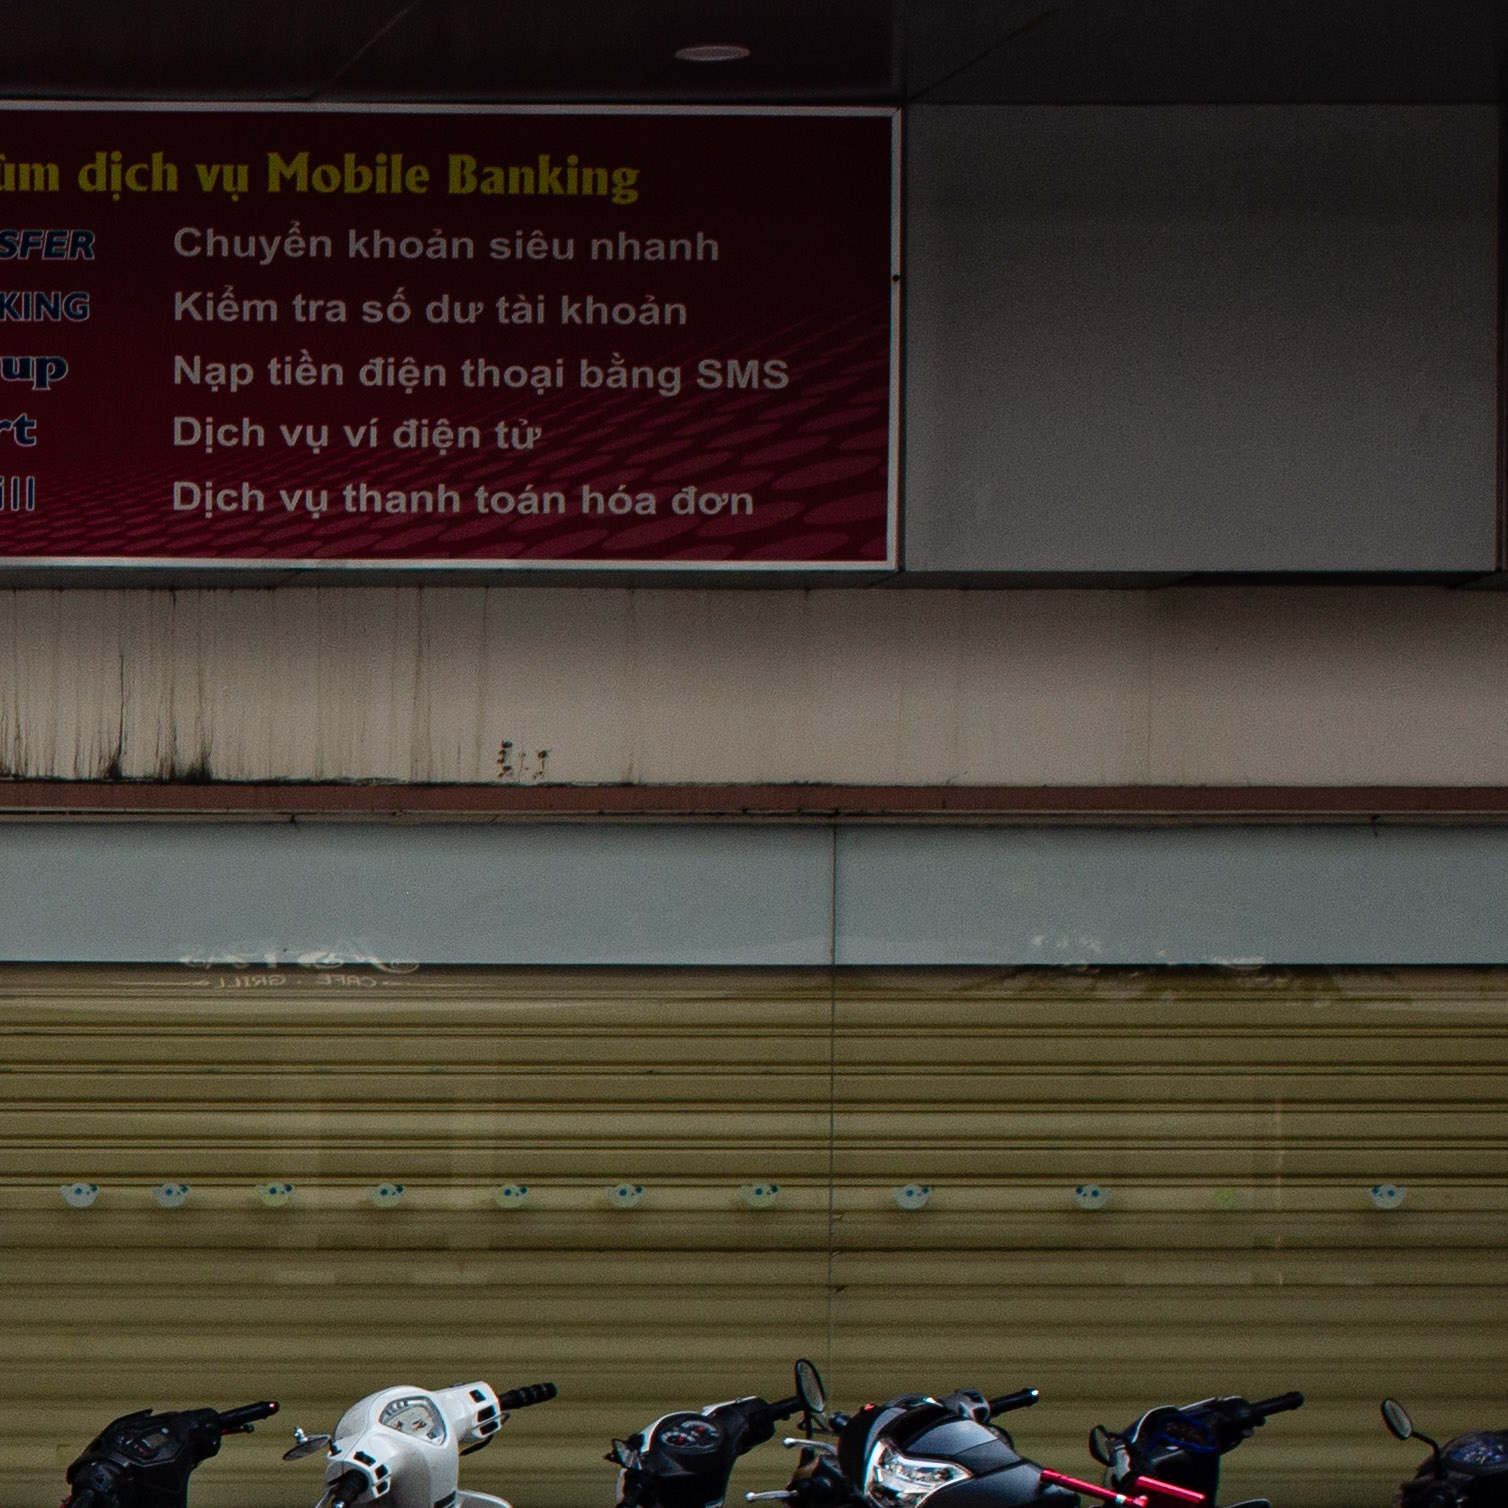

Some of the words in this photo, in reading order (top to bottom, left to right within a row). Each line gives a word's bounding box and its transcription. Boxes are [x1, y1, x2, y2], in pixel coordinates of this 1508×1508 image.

[76, 150, 179, 202] dịch
[194, 161, 250, 202] vụ
[266, 152, 431, 196] Mobile
[446, 152, 641, 206] Banking
[172, 220, 333, 266] Chuyển
[347, 226, 475, 261] khoản
[488, 227, 576, 261] siêu
[589, 231, 721, 262] nhanh
[173, 285, 278, 324] Kiểm
[291, 293, 348, 323] tra
[360, 286, 412, 324] số
[425, 293, 485, 324] dư
[495, 293, 546, 325] tài
[560, 294, 689, 326] khoản
[173, 354, 255, 394] Nạp
[267, 348, 345, 388] tiền
[358, 355, 448, 394] điện
[460, 356, 565, 395] thoại
[579, 350, 683, 399] bằng
[695, 358, 790, 391] SMS
[172, 415, 266, 454] Dịch
[279, 424, 330, 454] vụ
[343, 416, 379, 449] ví
[391, 417, 482, 456] điện
[494, 419, 544, 451] tử
[172, 480, 266, 519] Dịch
[279, 489, 330, 519] vụ
[343, 482, 461, 515] thanh
[474, 482, 567, 516] toán
[580, 483, 658, 516] hóa
[670, 484, 755, 517] đơn
